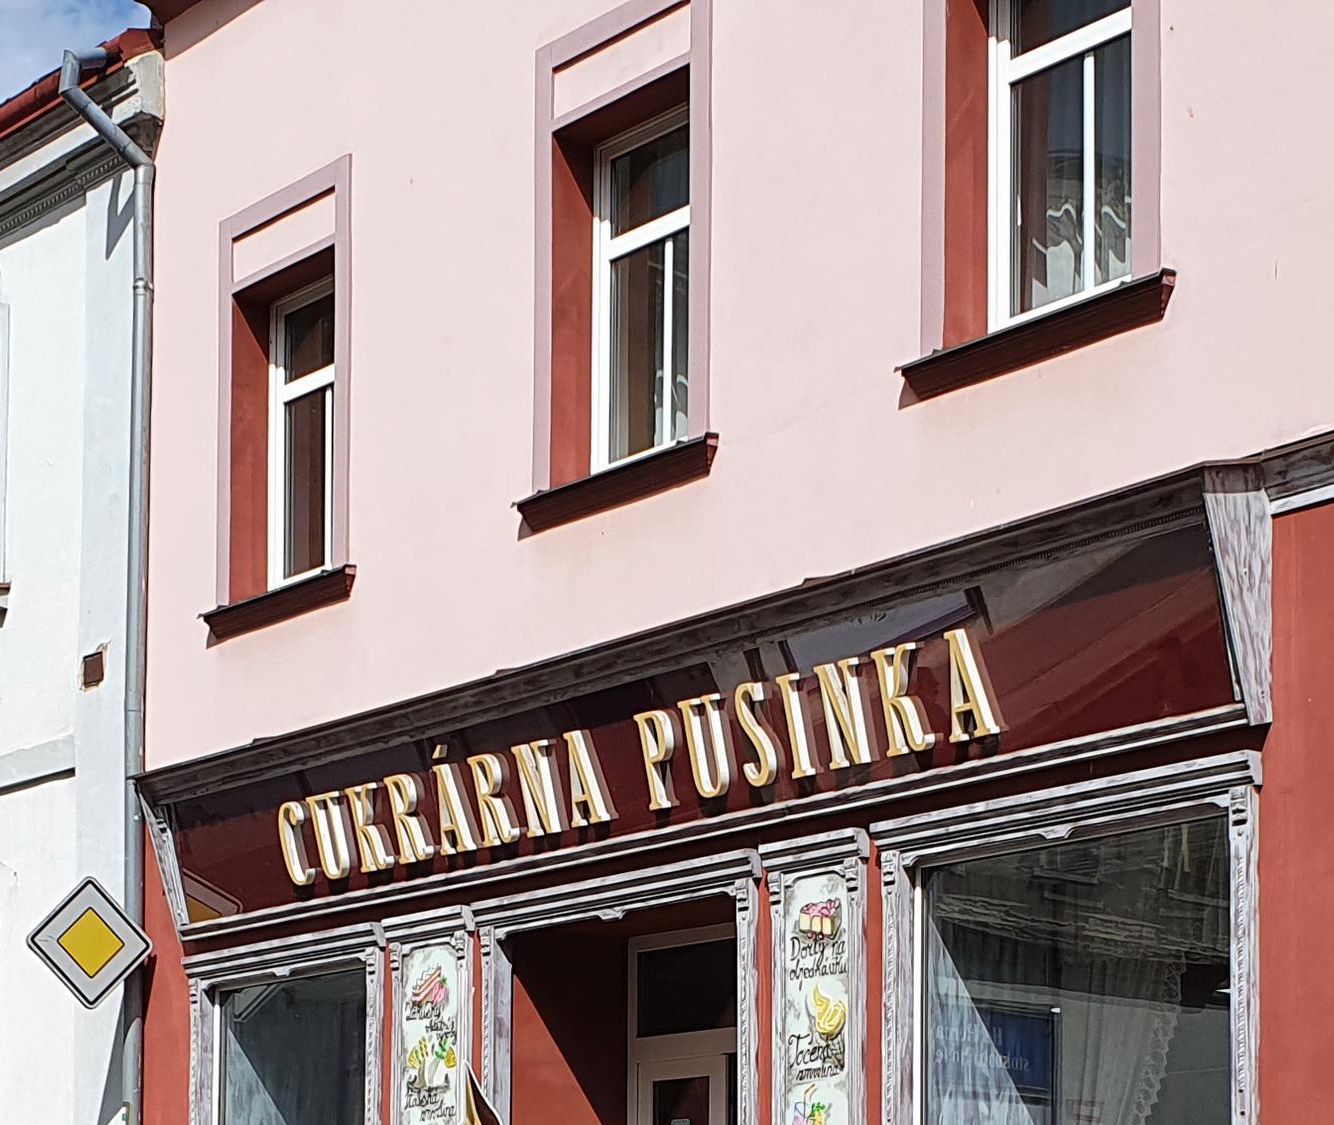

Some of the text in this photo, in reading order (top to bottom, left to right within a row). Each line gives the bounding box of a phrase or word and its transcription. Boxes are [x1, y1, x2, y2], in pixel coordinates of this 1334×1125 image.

[278, 627, 1003, 887] CUKRÁRNA PUSINKA
[790, 936, 827, 968] Dorty
